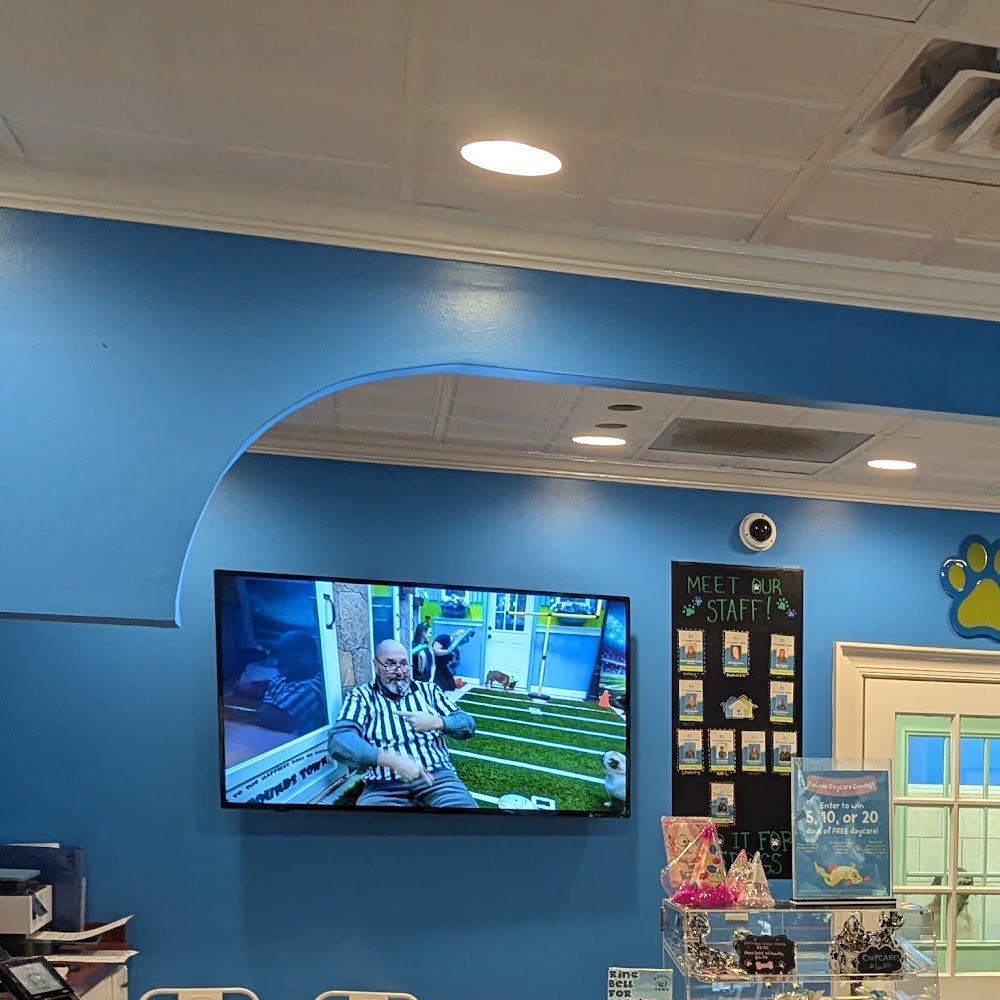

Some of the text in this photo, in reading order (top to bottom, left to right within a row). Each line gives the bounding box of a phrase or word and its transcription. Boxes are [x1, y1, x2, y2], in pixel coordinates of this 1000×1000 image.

[687, 576, 782, 595] MEET OUR
[829, 784, 852, 792] Daycare
[843, 813, 858, 824] or
[862, 810, 878, 823] 20
[823, 826, 831, 834] of
[850, 827, 879, 837] daycare!
